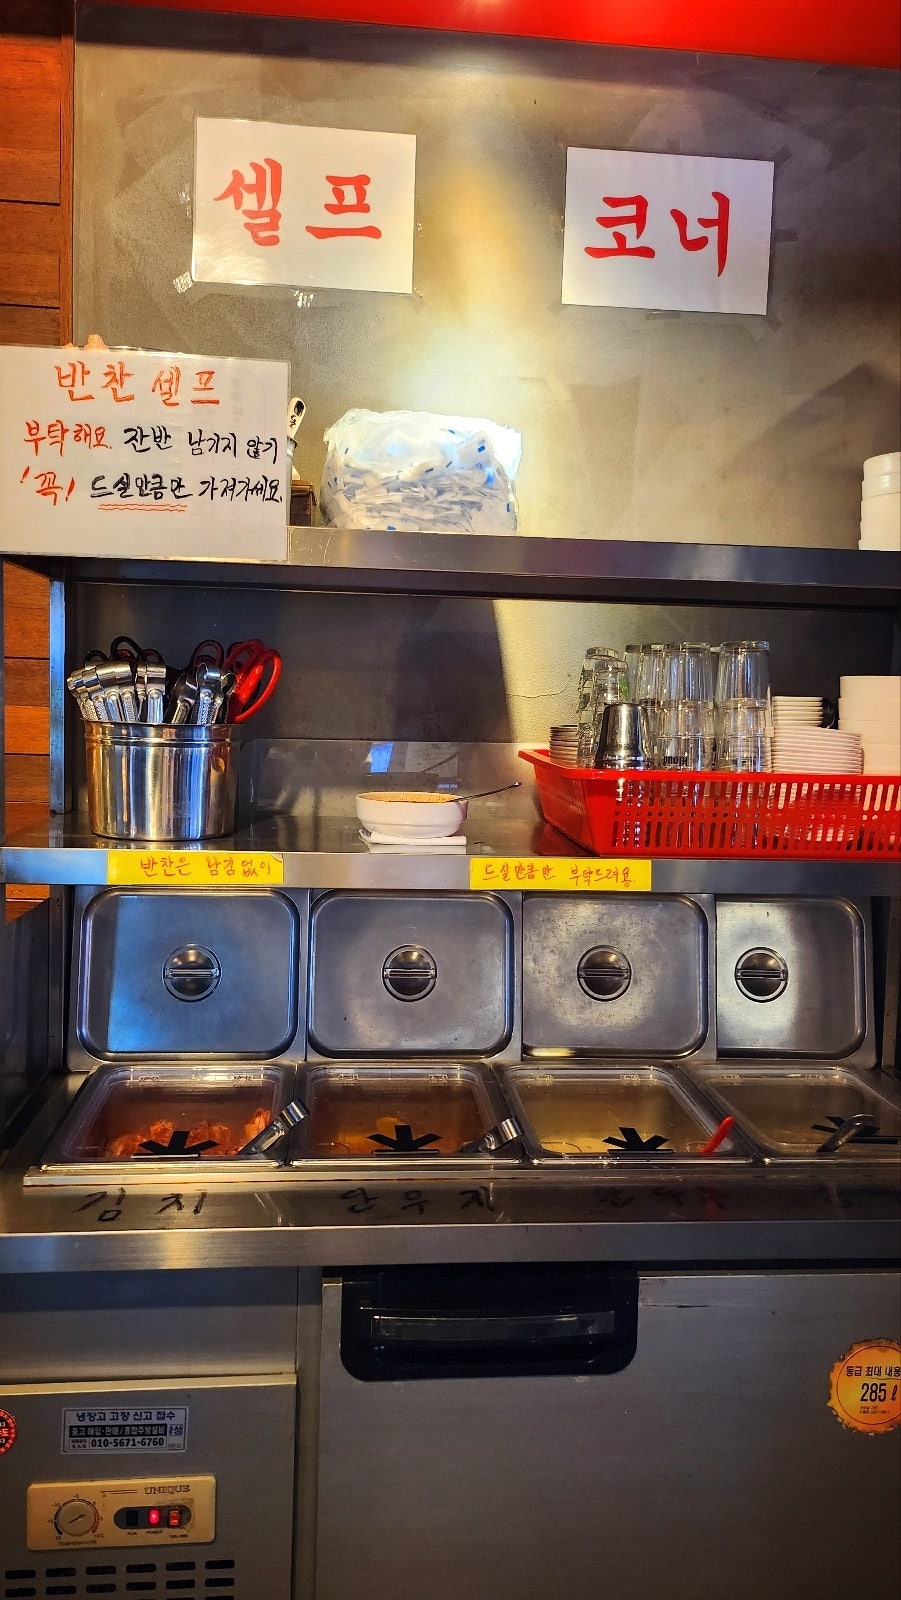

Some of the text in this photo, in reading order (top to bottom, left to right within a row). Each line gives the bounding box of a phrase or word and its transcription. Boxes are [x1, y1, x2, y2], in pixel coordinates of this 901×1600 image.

[213, 157, 732, 278] 셀프 코너
[54, 360, 220, 407] 반찬 셀프
[123, 425, 173, 453] 잔반
[188, 428, 237, 458] 남기지
[246, 436, 278, 464] 않기
[140, 855, 191, 877] 반찬은
[846, 1366, 862, 1377] 동급
[865, 1366, 882, 1377] 최대
[860, 1383, 887, 1402] 285
[76, 1411, 175, 1422] 냉장고 고장 신고 접수
[91, 1438, 164, 1448] 010-5671-6760
[144, 1485, 190, 1495] UNIQUE
